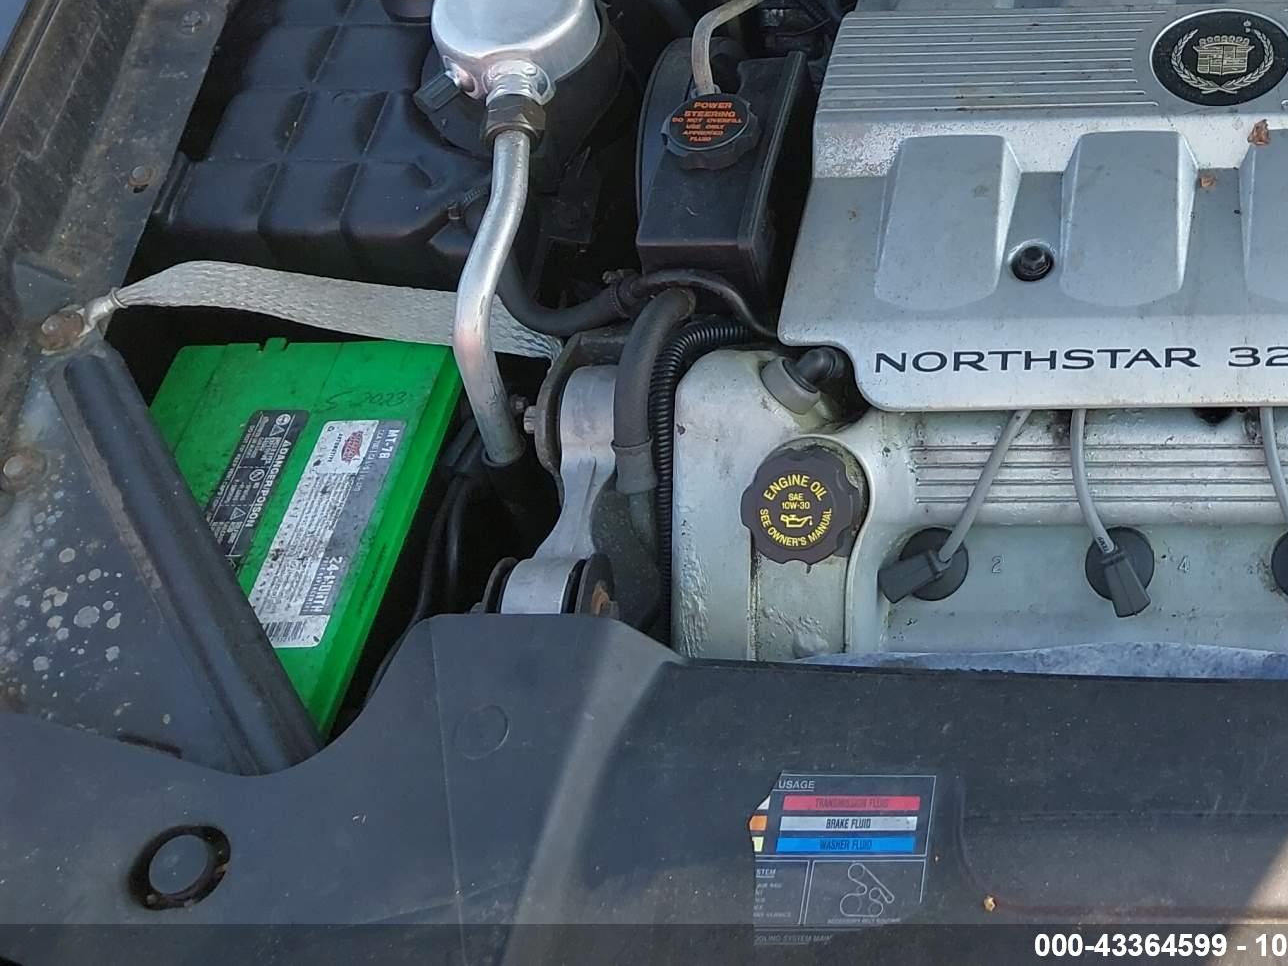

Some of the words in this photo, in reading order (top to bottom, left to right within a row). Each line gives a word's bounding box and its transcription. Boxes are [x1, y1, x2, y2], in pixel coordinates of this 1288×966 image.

[693, 101, 733, 109] POWER
[683, 110, 736, 118] STEERING
[874, 347, 1201, 373] NORTHSTAR
[763, 474, 811, 501] ENGINE
[810, 481, 828, 502] OIL
[788, 492, 804, 501] SAE
[782, 501, 811, 510] 10W-30
[760, 508, 773, 528] SEE
[767, 526, 808, 547] OWNER'S
[807, 507, 832, 543] MANUAL
[1177, 555, 1191, 574] 4
[778, 780, 815, 789] USAGE
[825, 818, 849, 829] BRAKE
[850, 818, 872, 829] FLUID
[820, 839, 850, 850] WASHER
[851, 839, 873, 850] FLUID
